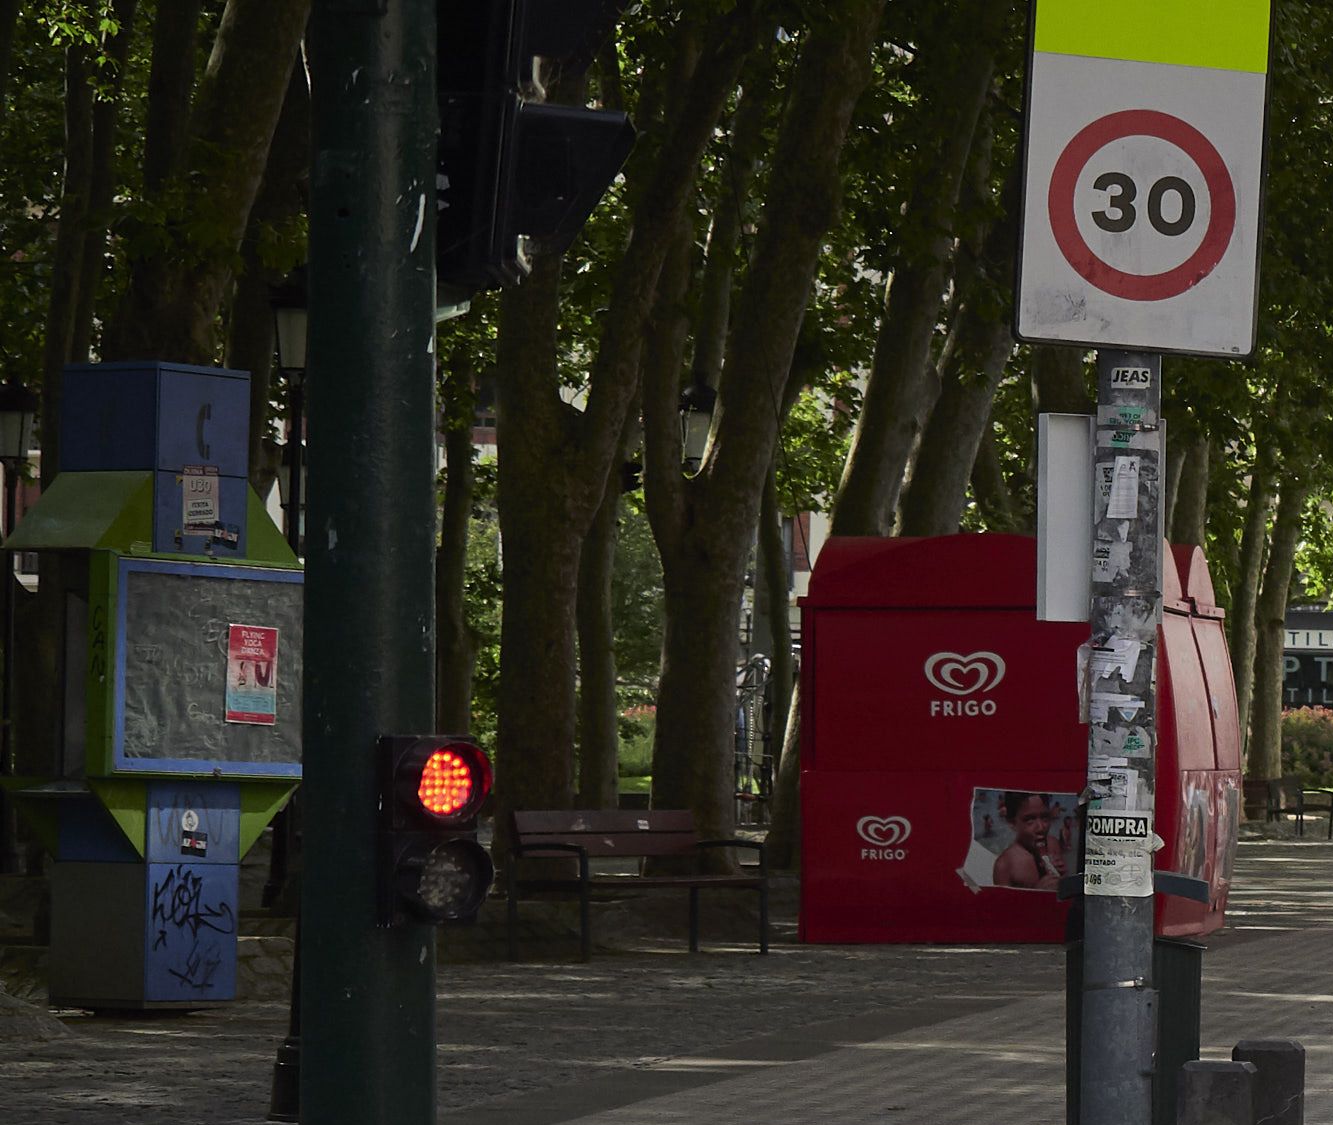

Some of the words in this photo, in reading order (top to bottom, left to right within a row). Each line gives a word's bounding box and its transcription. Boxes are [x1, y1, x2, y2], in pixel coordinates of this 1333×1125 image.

[1091, 171, 1196, 237] 30
[1113, 370, 1149, 383] JEAS
[930, 700, 997, 717] FRIGO
[860, 849, 907, 861] FRIGO
